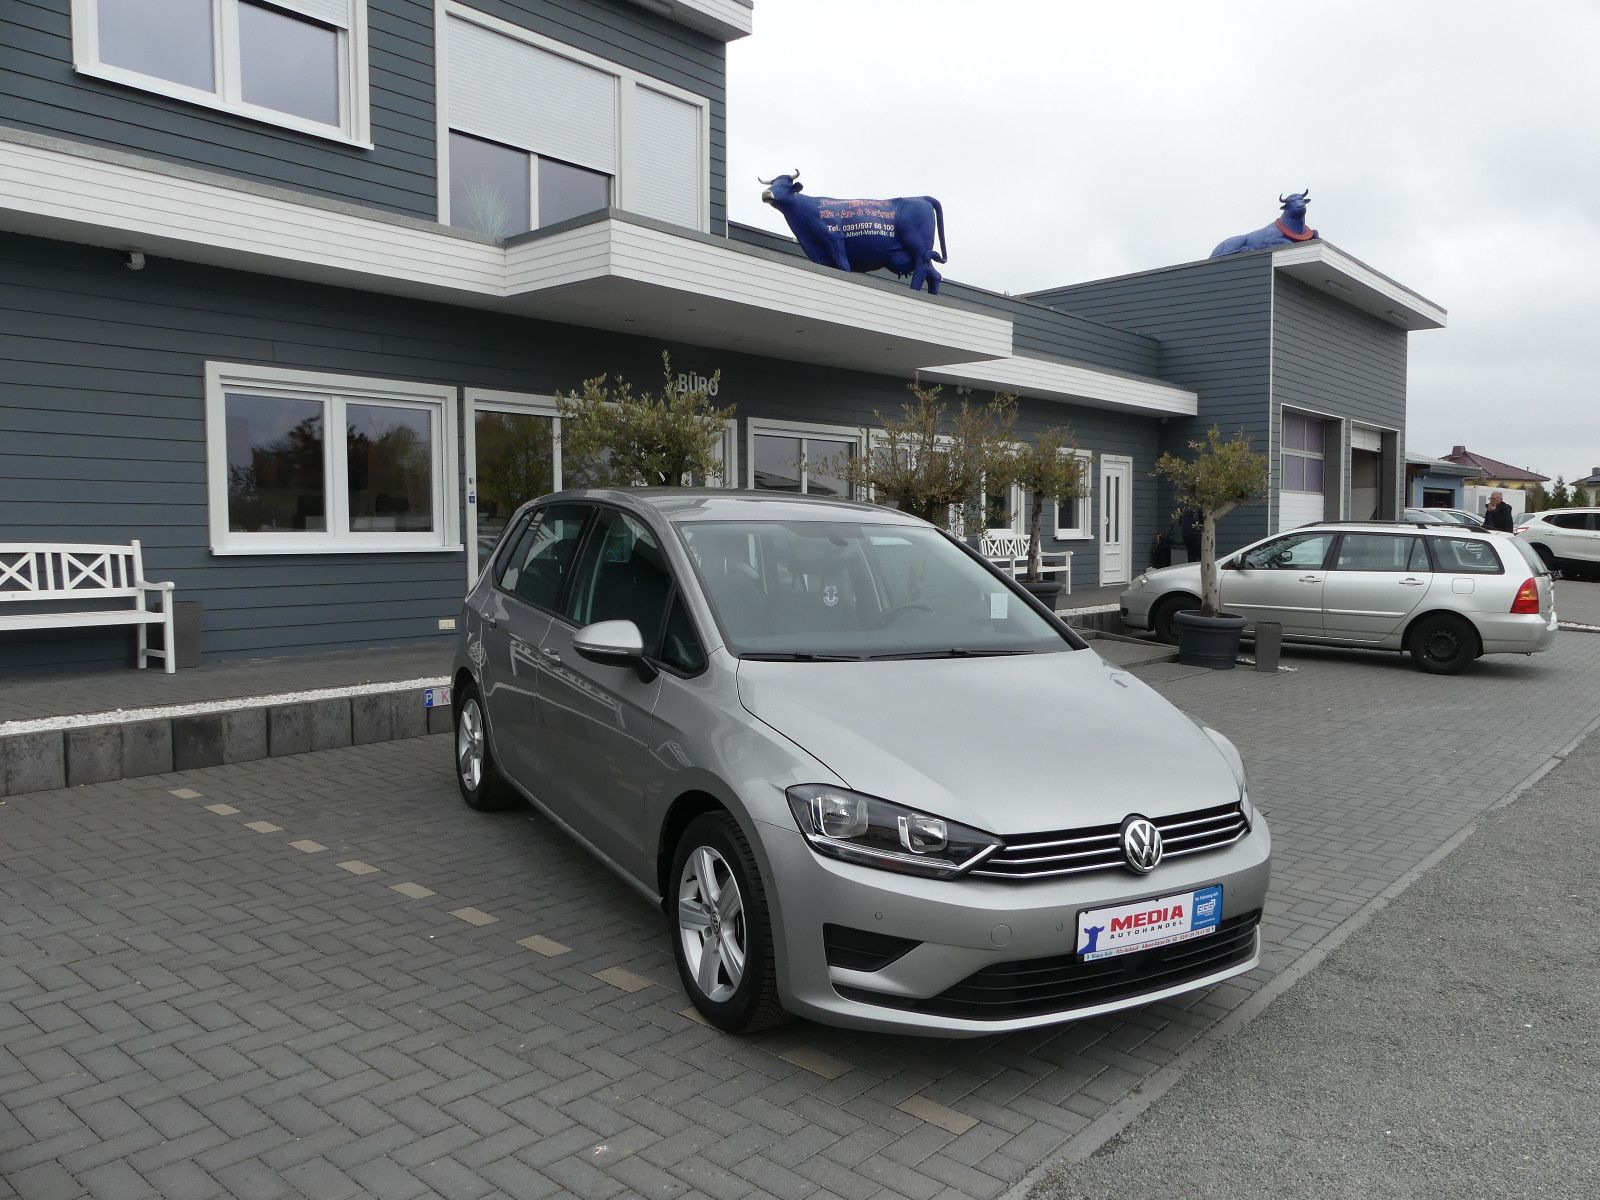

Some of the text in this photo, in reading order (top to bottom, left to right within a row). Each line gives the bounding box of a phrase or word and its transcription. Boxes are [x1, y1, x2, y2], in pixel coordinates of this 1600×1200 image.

[842, 222, 872, 232] 0391/597
[678, 371, 718, 396] BÜRO
[1111, 904, 1183, 932] MEDIA
[1110, 920, 1184, 940] AUTOHANDEL
